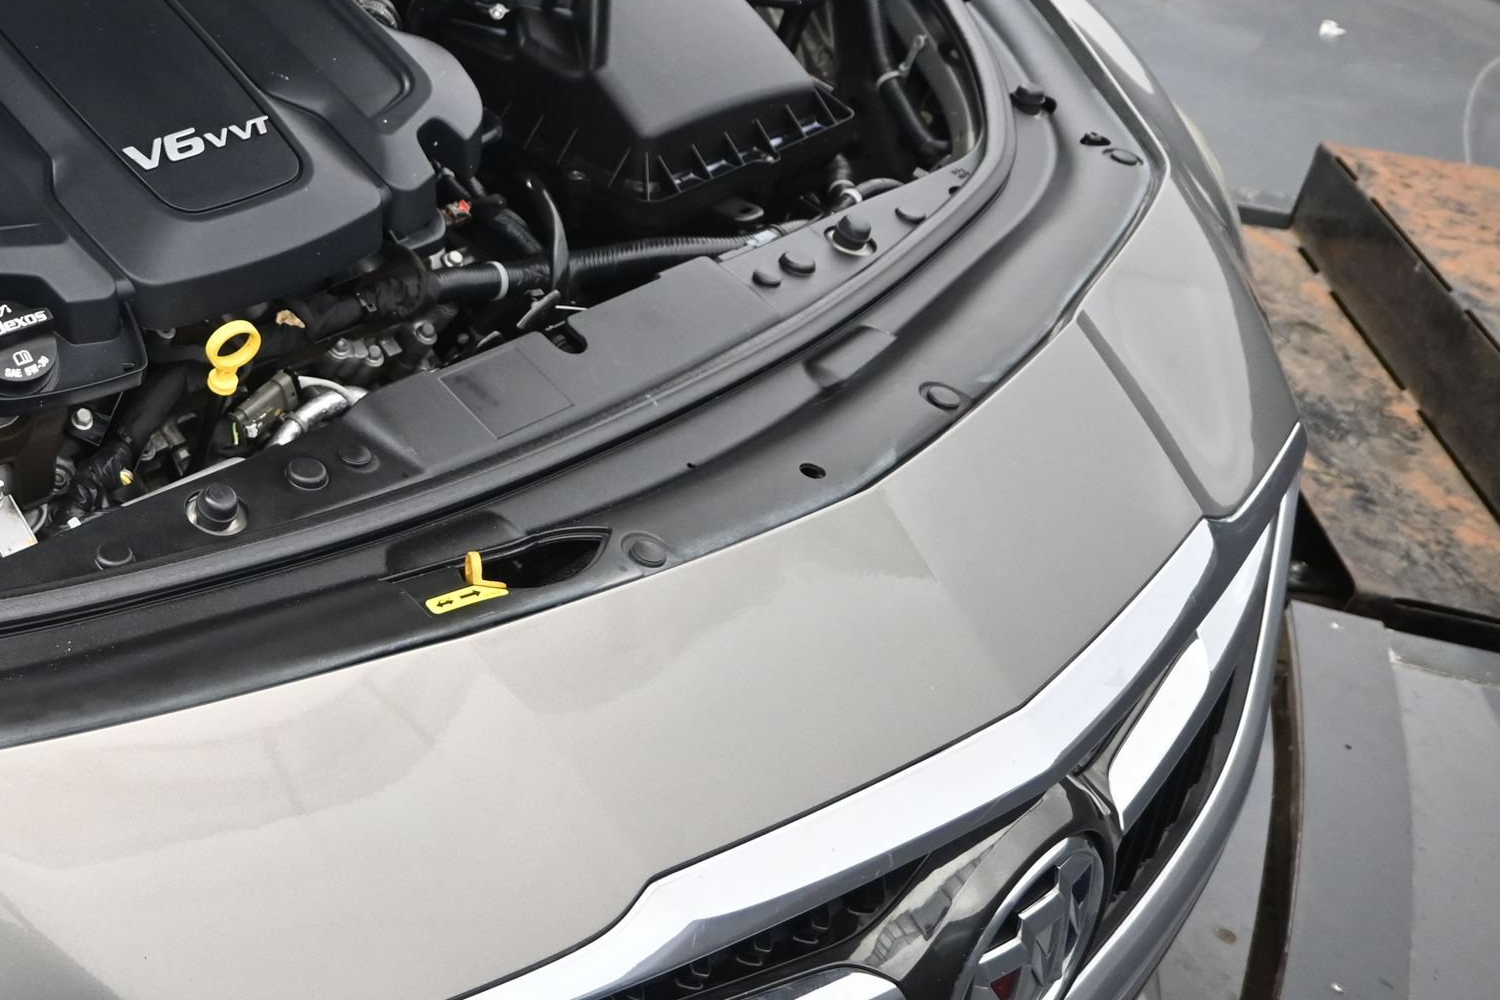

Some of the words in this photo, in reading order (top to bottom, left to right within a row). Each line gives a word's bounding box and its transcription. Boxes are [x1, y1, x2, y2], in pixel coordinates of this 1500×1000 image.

[122, 127, 205, 170] V6
[203, 115, 269, 148] VVT
[4, 367, 23, 378] SAE
[24, 355, 50, 377] 5W-30
